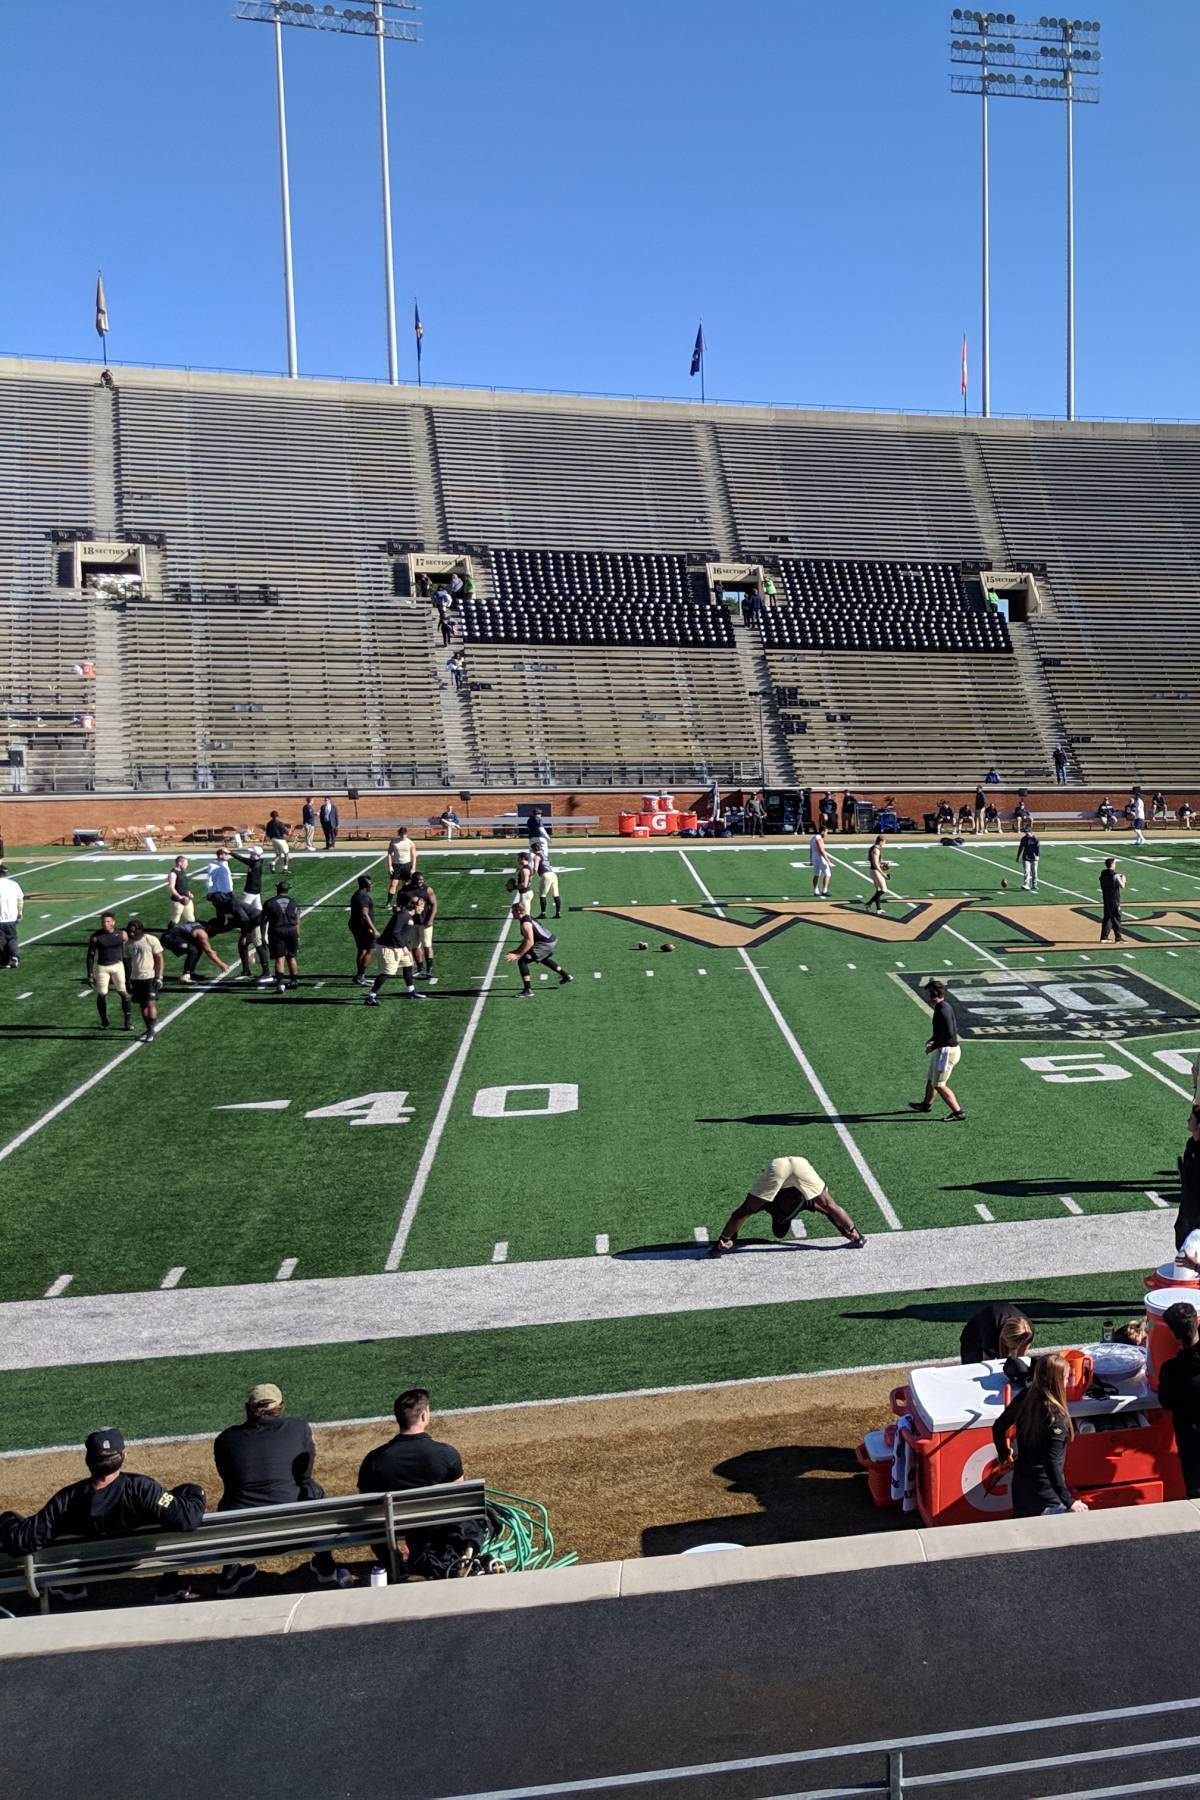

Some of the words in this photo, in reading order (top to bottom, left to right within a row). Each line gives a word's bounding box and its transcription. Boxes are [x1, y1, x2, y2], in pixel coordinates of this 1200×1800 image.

[83, 547, 95, 555] 18
[416, 559, 425, 567] 17
[713, 567, 722, 575] 16
[986, 576, 995, 584] 15
[651, 814, 667, 830] G
[947, 982, 1150, 1015] 50
[981, 1008, 1167, 1024] YEARS
[967, 1022, 1068, 1035] BB&T
[304, 1083, 579, 1126] 40
